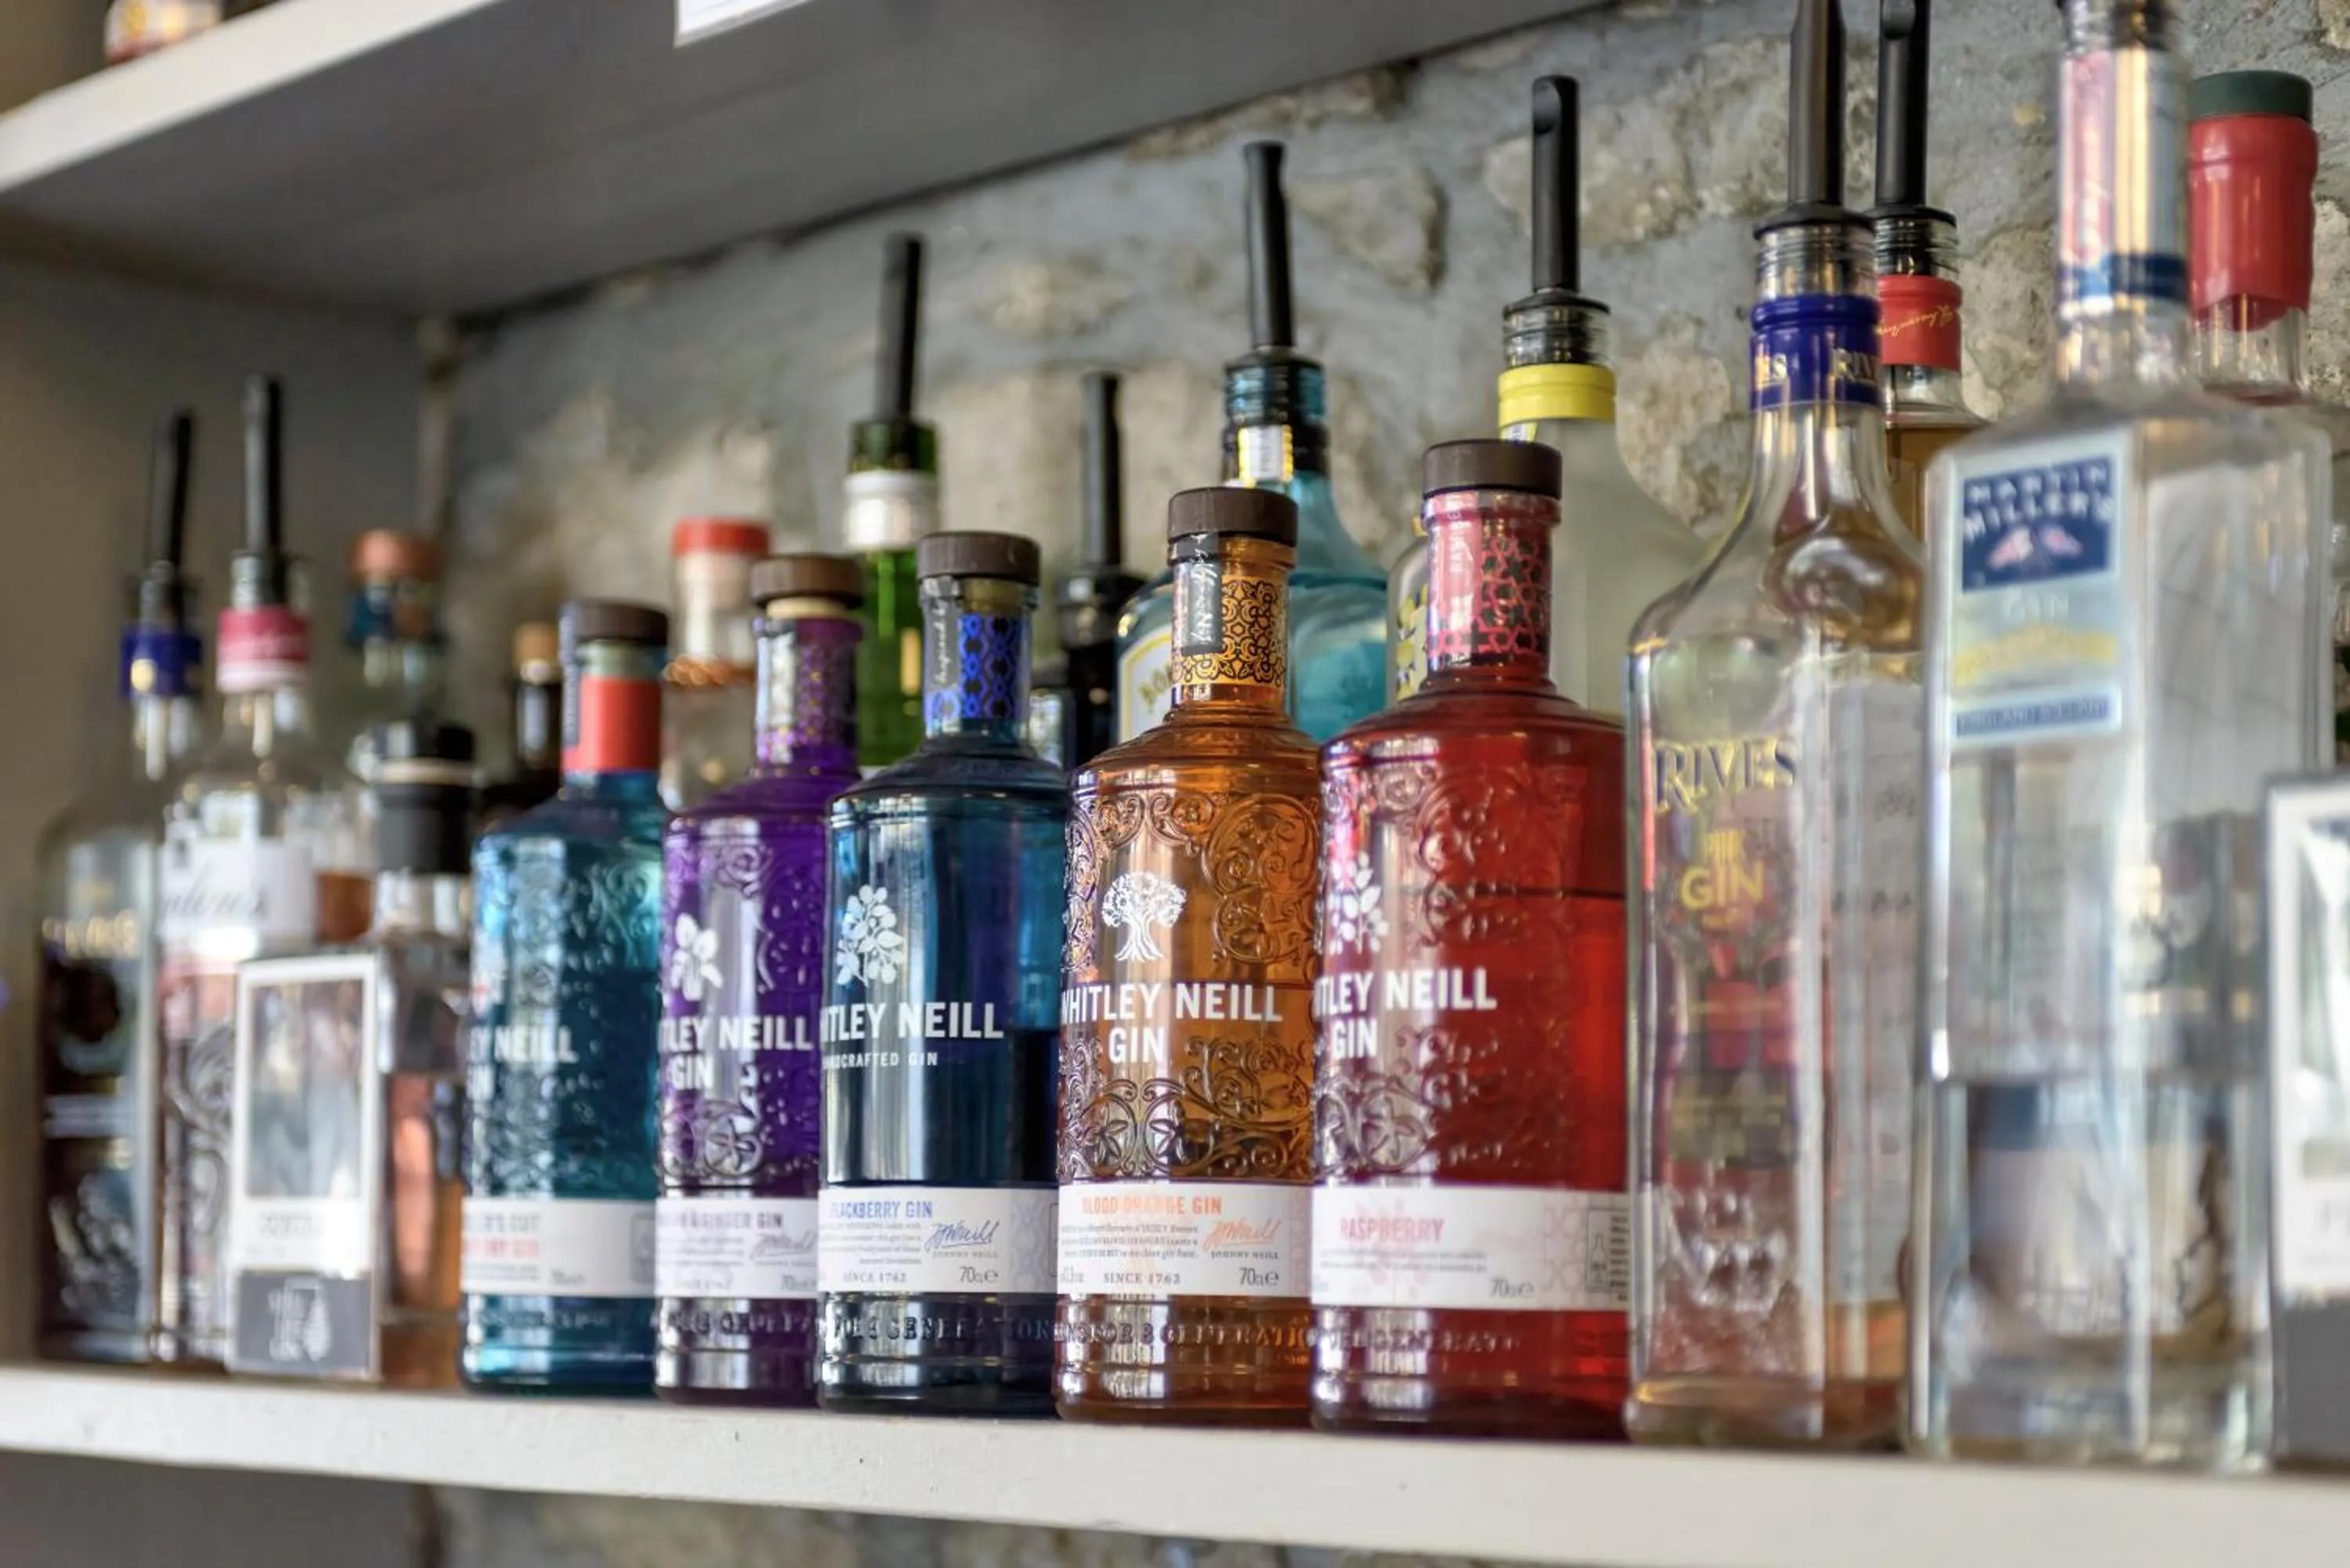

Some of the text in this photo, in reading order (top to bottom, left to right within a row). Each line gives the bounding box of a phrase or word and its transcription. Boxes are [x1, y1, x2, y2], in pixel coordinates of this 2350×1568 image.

[1653, 736, 1797, 816] RIVES
[1680, 860, 1764, 910] GIN
[1175, 982, 1283, 1022] NEILL
[1385, 966, 1497, 1010] NEILL
[718, 1015, 814, 1050] NEILL
[898, 1002, 1004, 1039] NEILL
[1332, 1018, 1378, 1058] GIN
[495, 1025, 580, 1064] NEILL
[908, 1052, 938, 1066] GIN
[1108, 1026, 1166, 1064] GIN
[672, 1053, 714, 1090] GIN
[906, 1201, 934, 1218] GIN
[1082, 1197, 1118, 1214] BLOOD
[1191, 1197, 1222, 1214] GIN
[1340, 1217, 1446, 1244] RASPBERRY
[1103, 1273, 1143, 1284] SINCE
